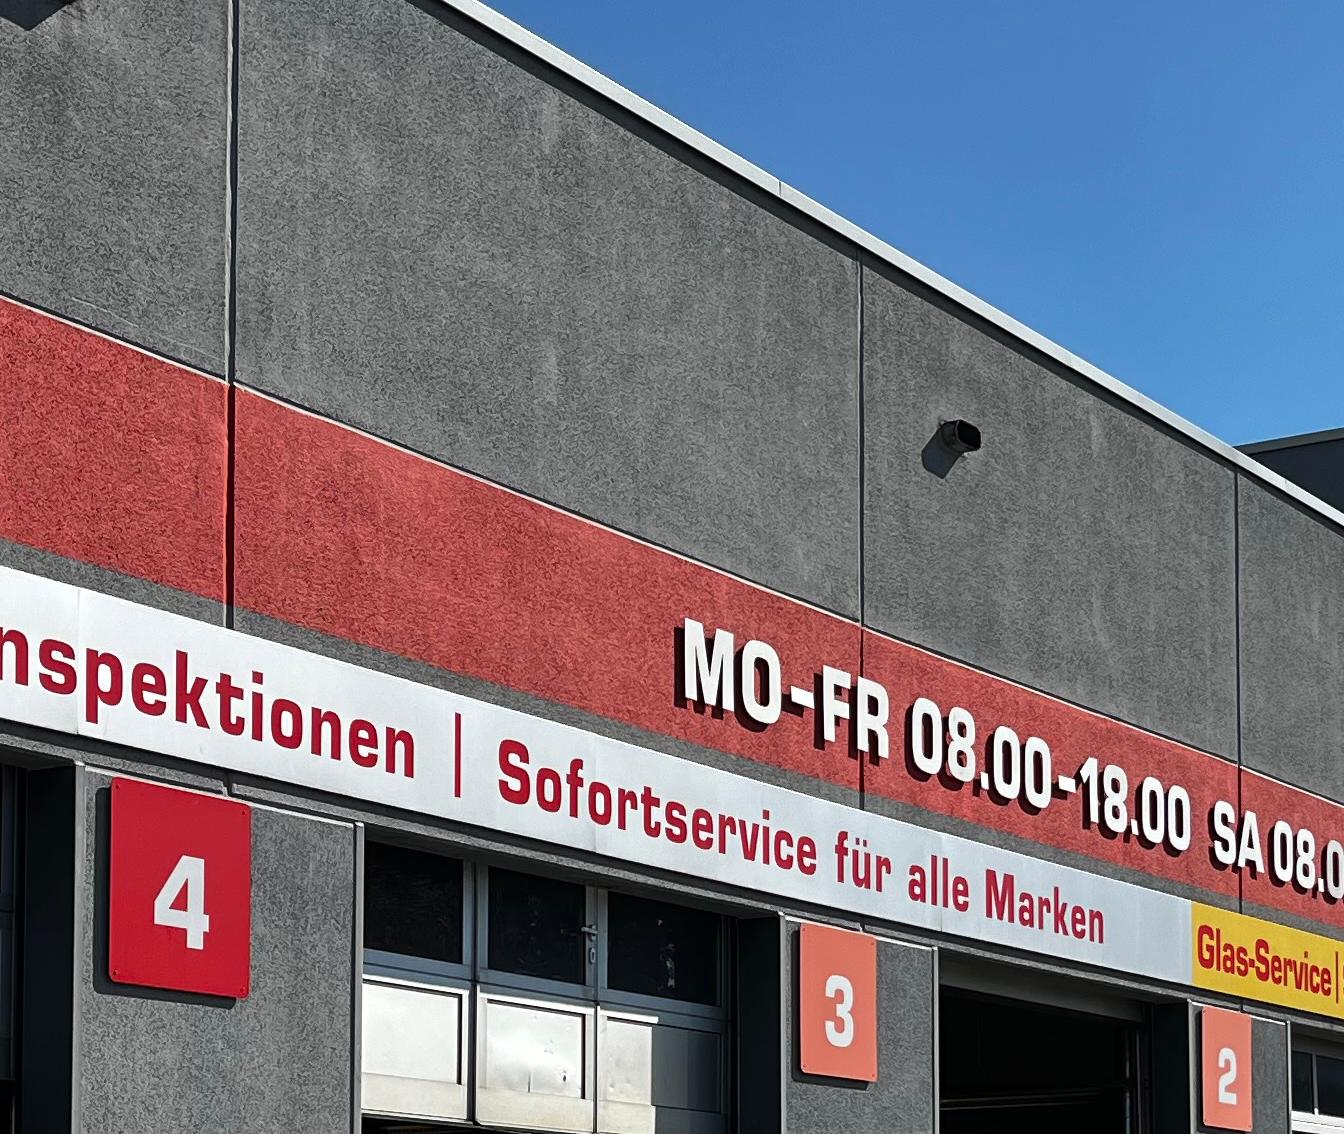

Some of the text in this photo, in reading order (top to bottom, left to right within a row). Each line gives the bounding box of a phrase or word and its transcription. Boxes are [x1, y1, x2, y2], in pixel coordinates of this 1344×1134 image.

[684, 617, 890, 760] MO-FR
[911, 697, 1191, 851] 08.00-18.00
[1213, 800, 1266, 874] SA
[499, 739, 818, 875] Sofortservice
[835, 831, 892, 892] für
[908, 856, 970, 912] alle
[985, 869, 1105, 943] Marken
[154, 855, 210, 950] 4
[1197, 925, 1332, 996] Glas-Service
[824, 974, 855, 1048] 3
[1218, 1047, 1238, 1106] 2
